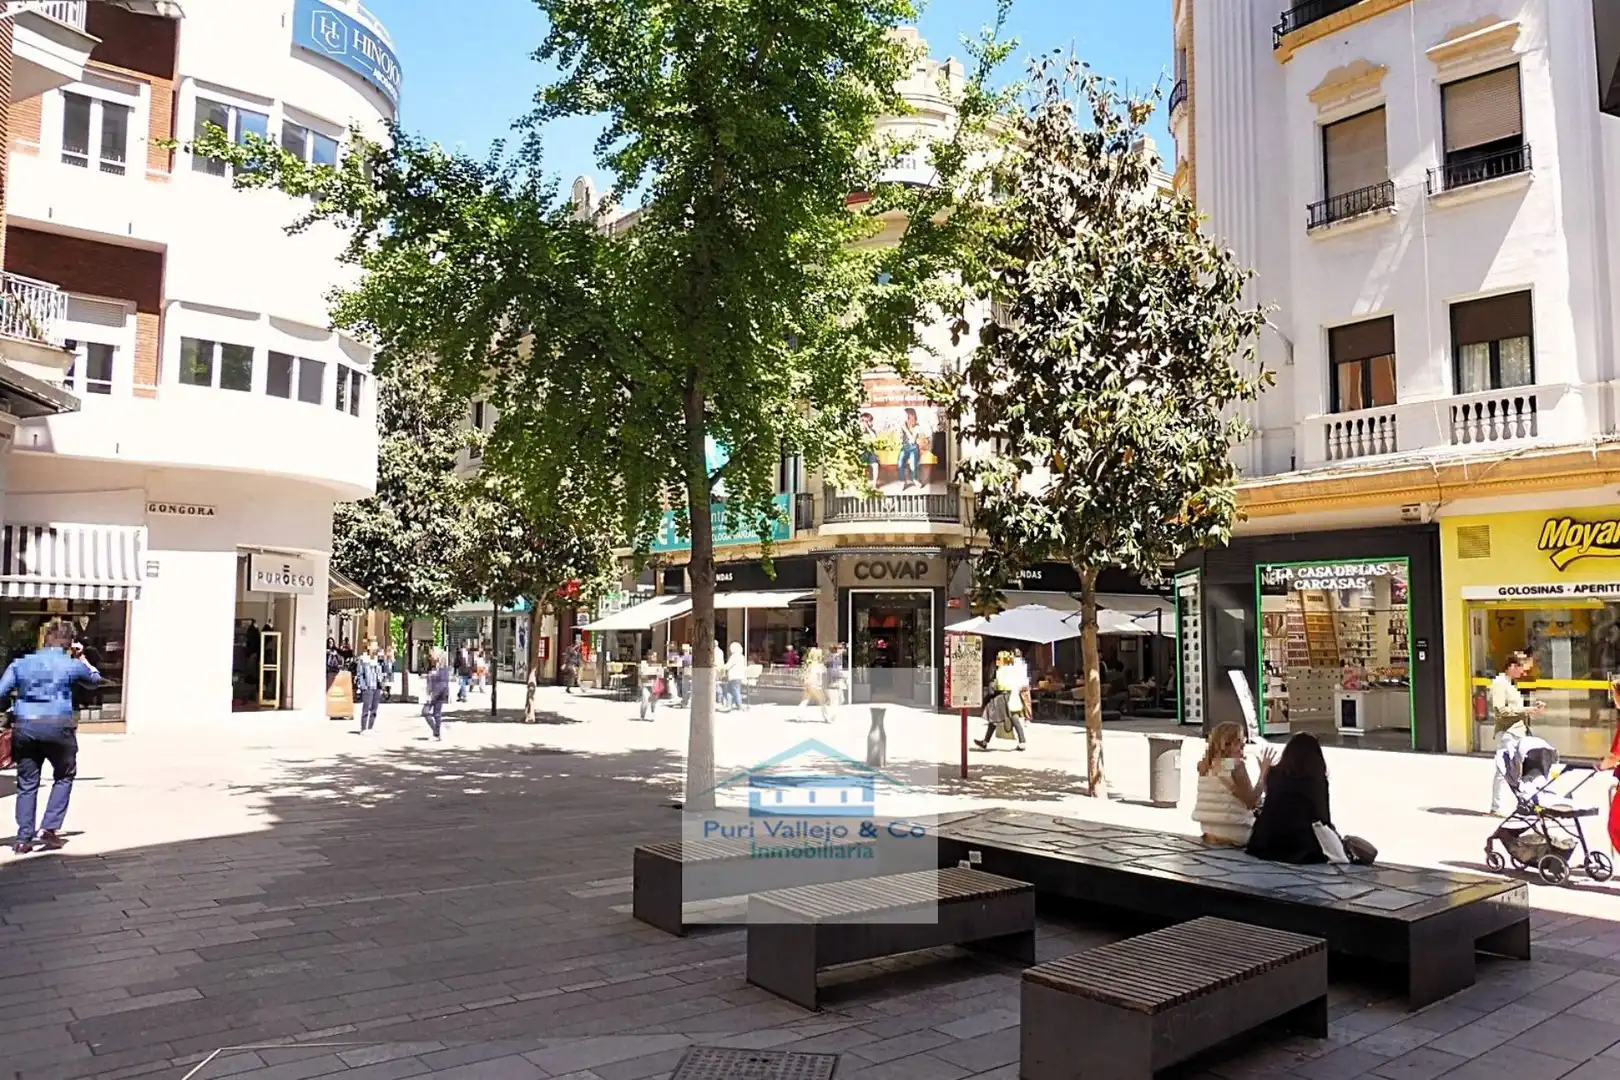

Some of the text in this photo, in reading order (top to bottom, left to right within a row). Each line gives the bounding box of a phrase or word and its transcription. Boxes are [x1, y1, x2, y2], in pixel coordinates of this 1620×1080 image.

[352, 28, 401, 86] HINOJO
[148, 503, 215, 516] GONGORA
[854, 561, 929, 580] COVAP
[1297, 567, 1334, 578] CASA
[1358, 564, 1389, 576] LAS
[257, 571, 314, 587] PUROEGO
[1293, 578, 1367, 590] CARCASAS
[1498, 585, 1564, 596] GOLOSINAS
